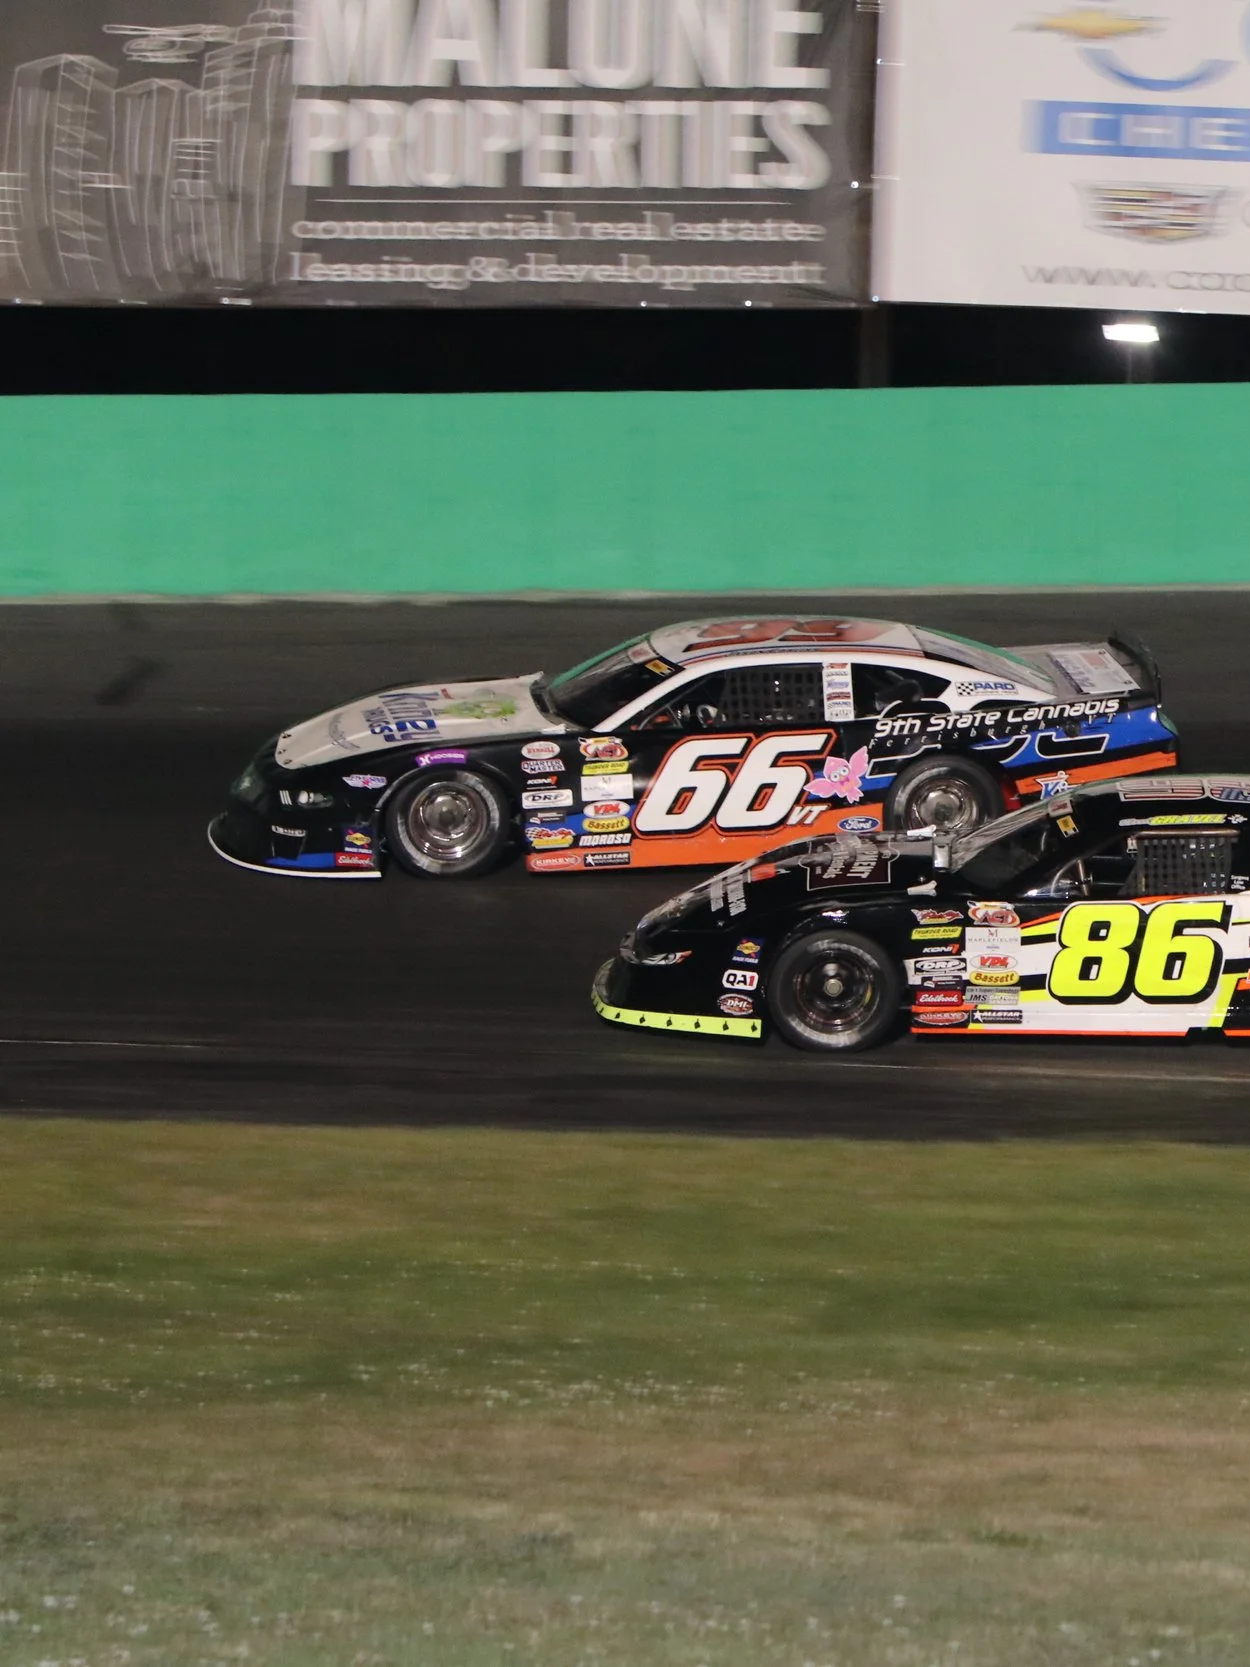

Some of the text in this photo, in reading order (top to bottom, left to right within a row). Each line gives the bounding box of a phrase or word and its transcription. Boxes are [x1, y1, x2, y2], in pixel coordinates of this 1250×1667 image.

[293, 0, 830, 89] MALONE
[292, 98, 831, 189] PROPERTIES
[291, 210, 825, 242] commercial real estate
[289, 252, 469, 290] leasing
[514, 252, 825, 290] development
[874, 717, 922, 738] 9th
[926, 711, 1001, 732] State
[633, 731, 834, 837] 66
[587, 818, 625, 830] Bassett
[786, 806, 827, 825] VT
[844, 817, 873, 830] Ford
[1049, 901, 1230, 1004] 86
[726, 972, 755, 987] QA1
[974, 972, 1015, 983] Bassett
